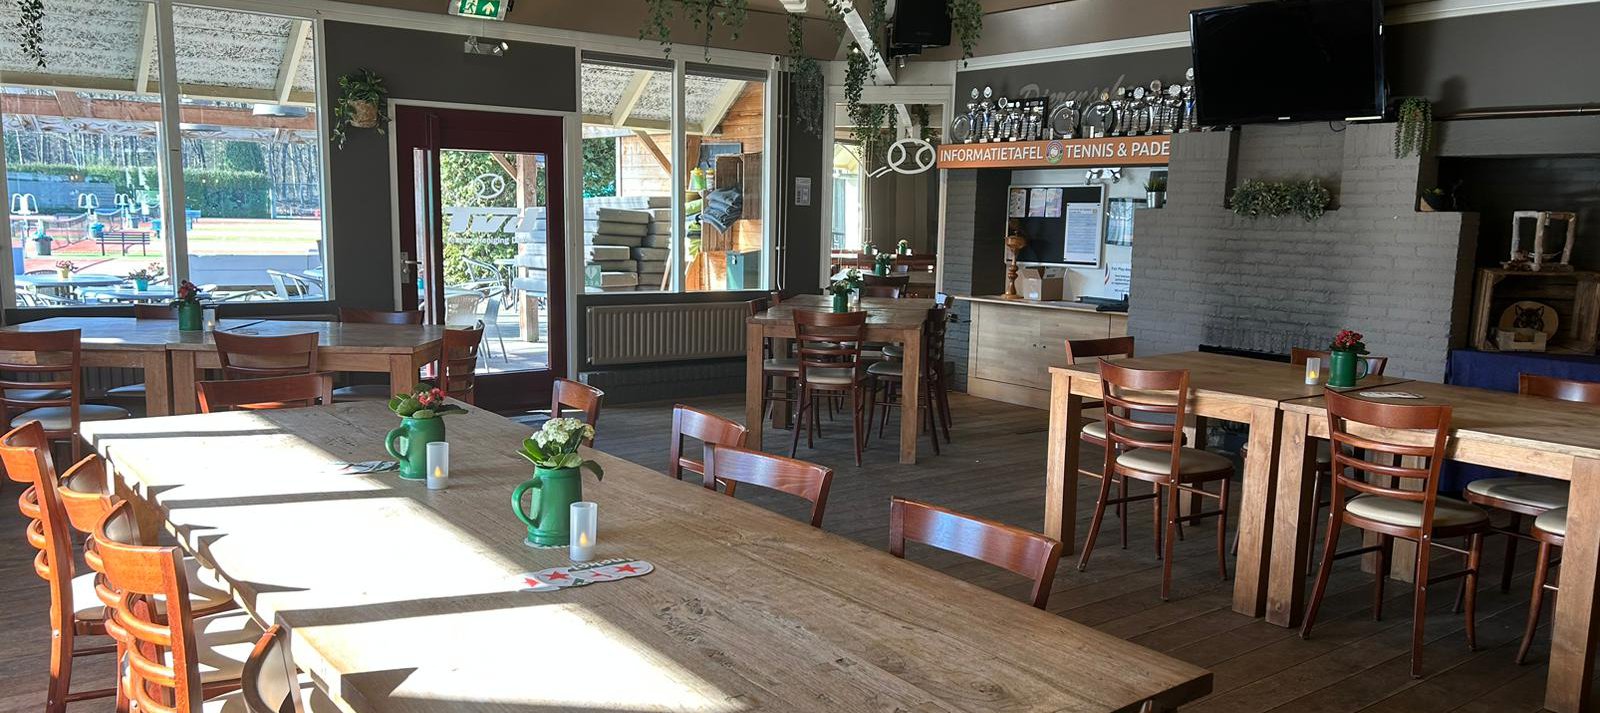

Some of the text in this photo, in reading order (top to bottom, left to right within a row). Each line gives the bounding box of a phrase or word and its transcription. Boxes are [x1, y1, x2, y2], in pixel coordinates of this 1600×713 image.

[940, 146, 1044, 162] INFORMATIETAFEL
[1066, 143, 1114, 158] TENNIS
[1117, 142, 1127, 157] &
